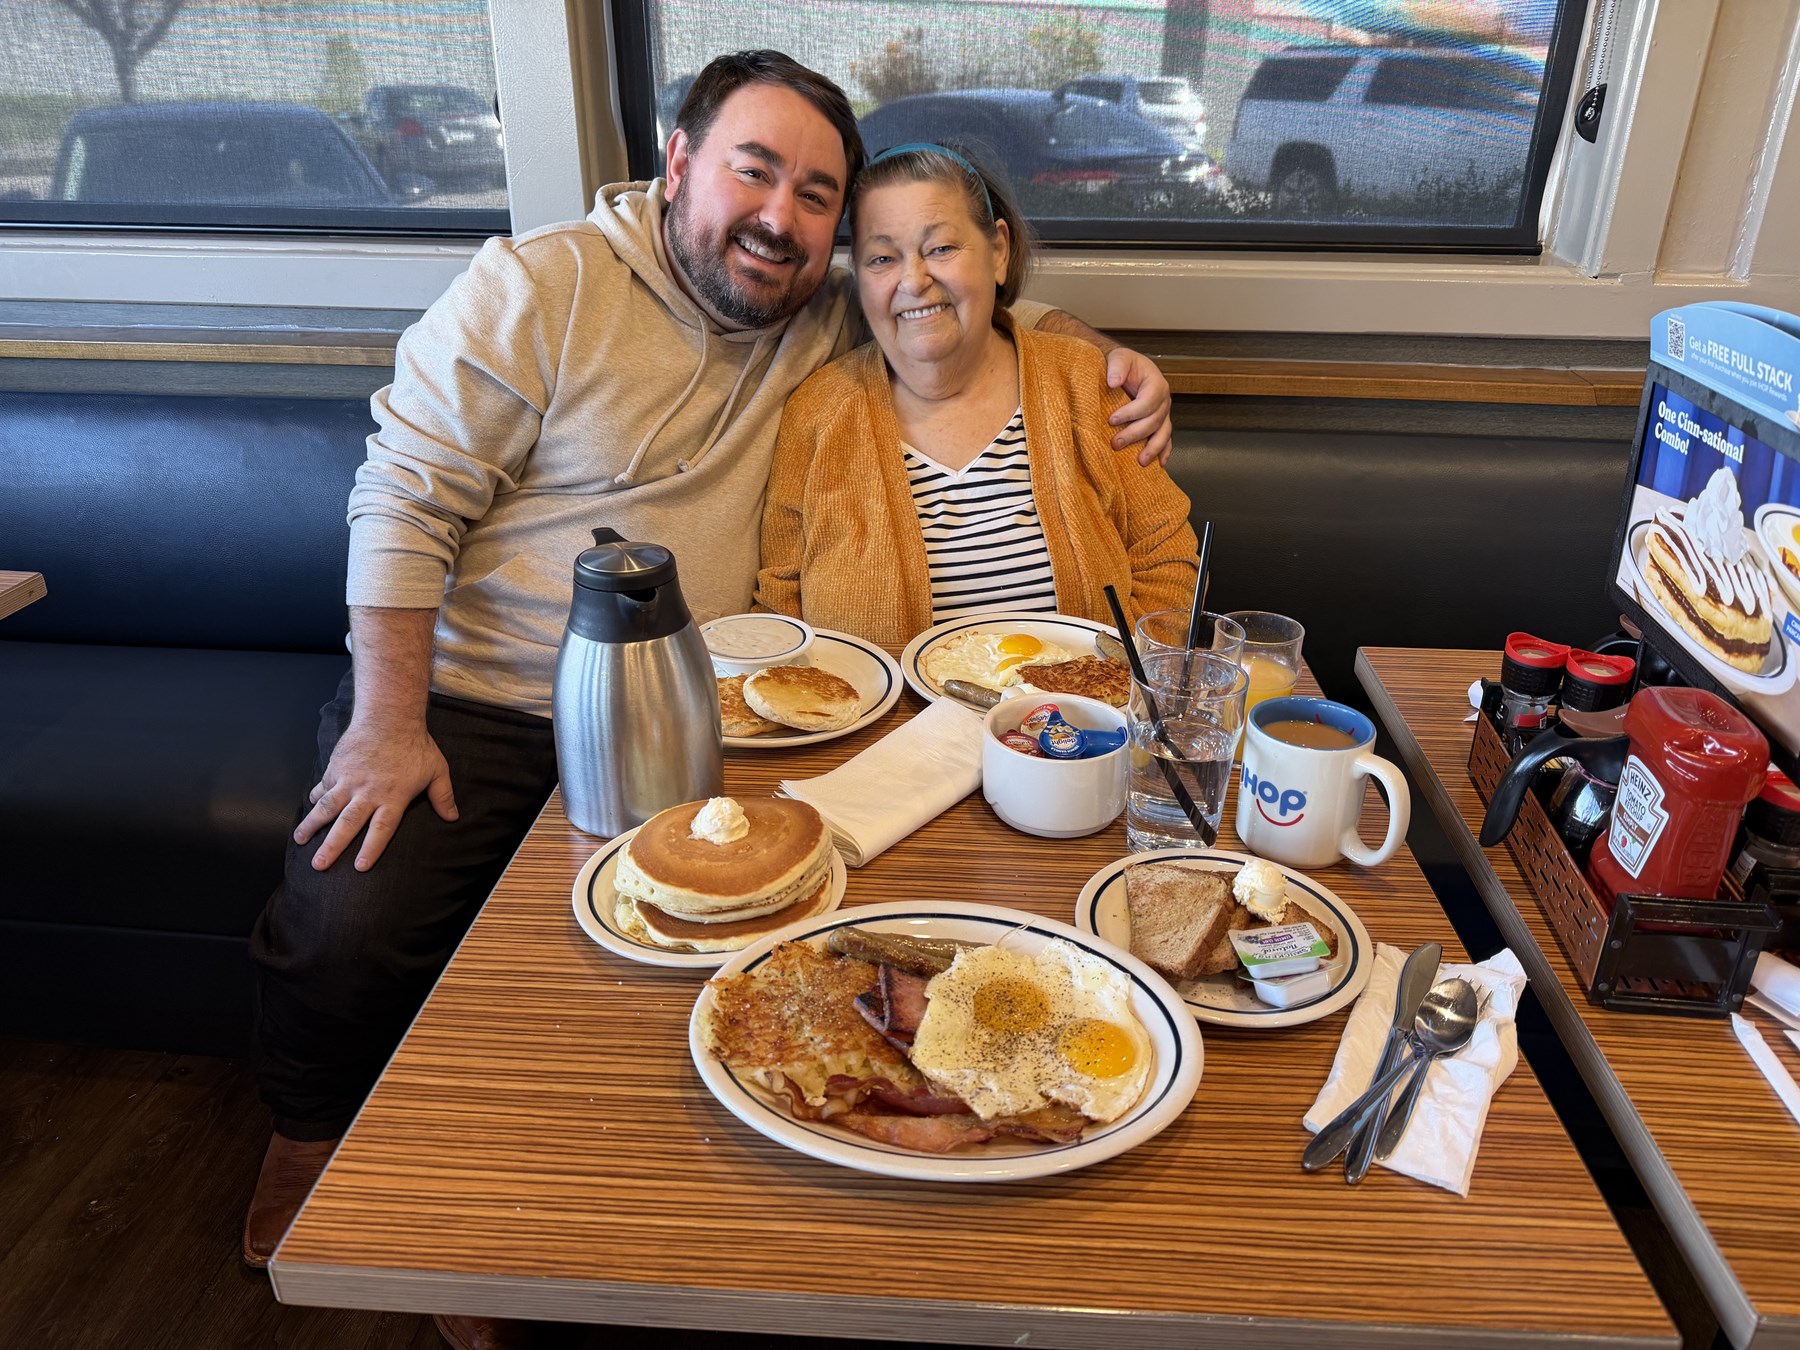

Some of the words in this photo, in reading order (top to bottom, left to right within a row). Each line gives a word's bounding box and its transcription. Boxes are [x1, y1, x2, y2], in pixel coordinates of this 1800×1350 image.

[1689, 336, 1702, 352] Get
[1702, 344, 1707, 355] a
[1707, 340, 1730, 365] FREE
[1731, 350, 1756, 377] FULL
[1757, 361, 1793, 393] STACK
[1654, 422, 1690, 456] Combo!
[1658, 401, 1676, 425] One
[1677, 411, 1744, 464] Cinn-sational
[1626, 788, 1646, 816] TOMATO
[1630, 771, 1652, 801] HEINZ
[1624, 799, 1643, 823] KETCHUP
